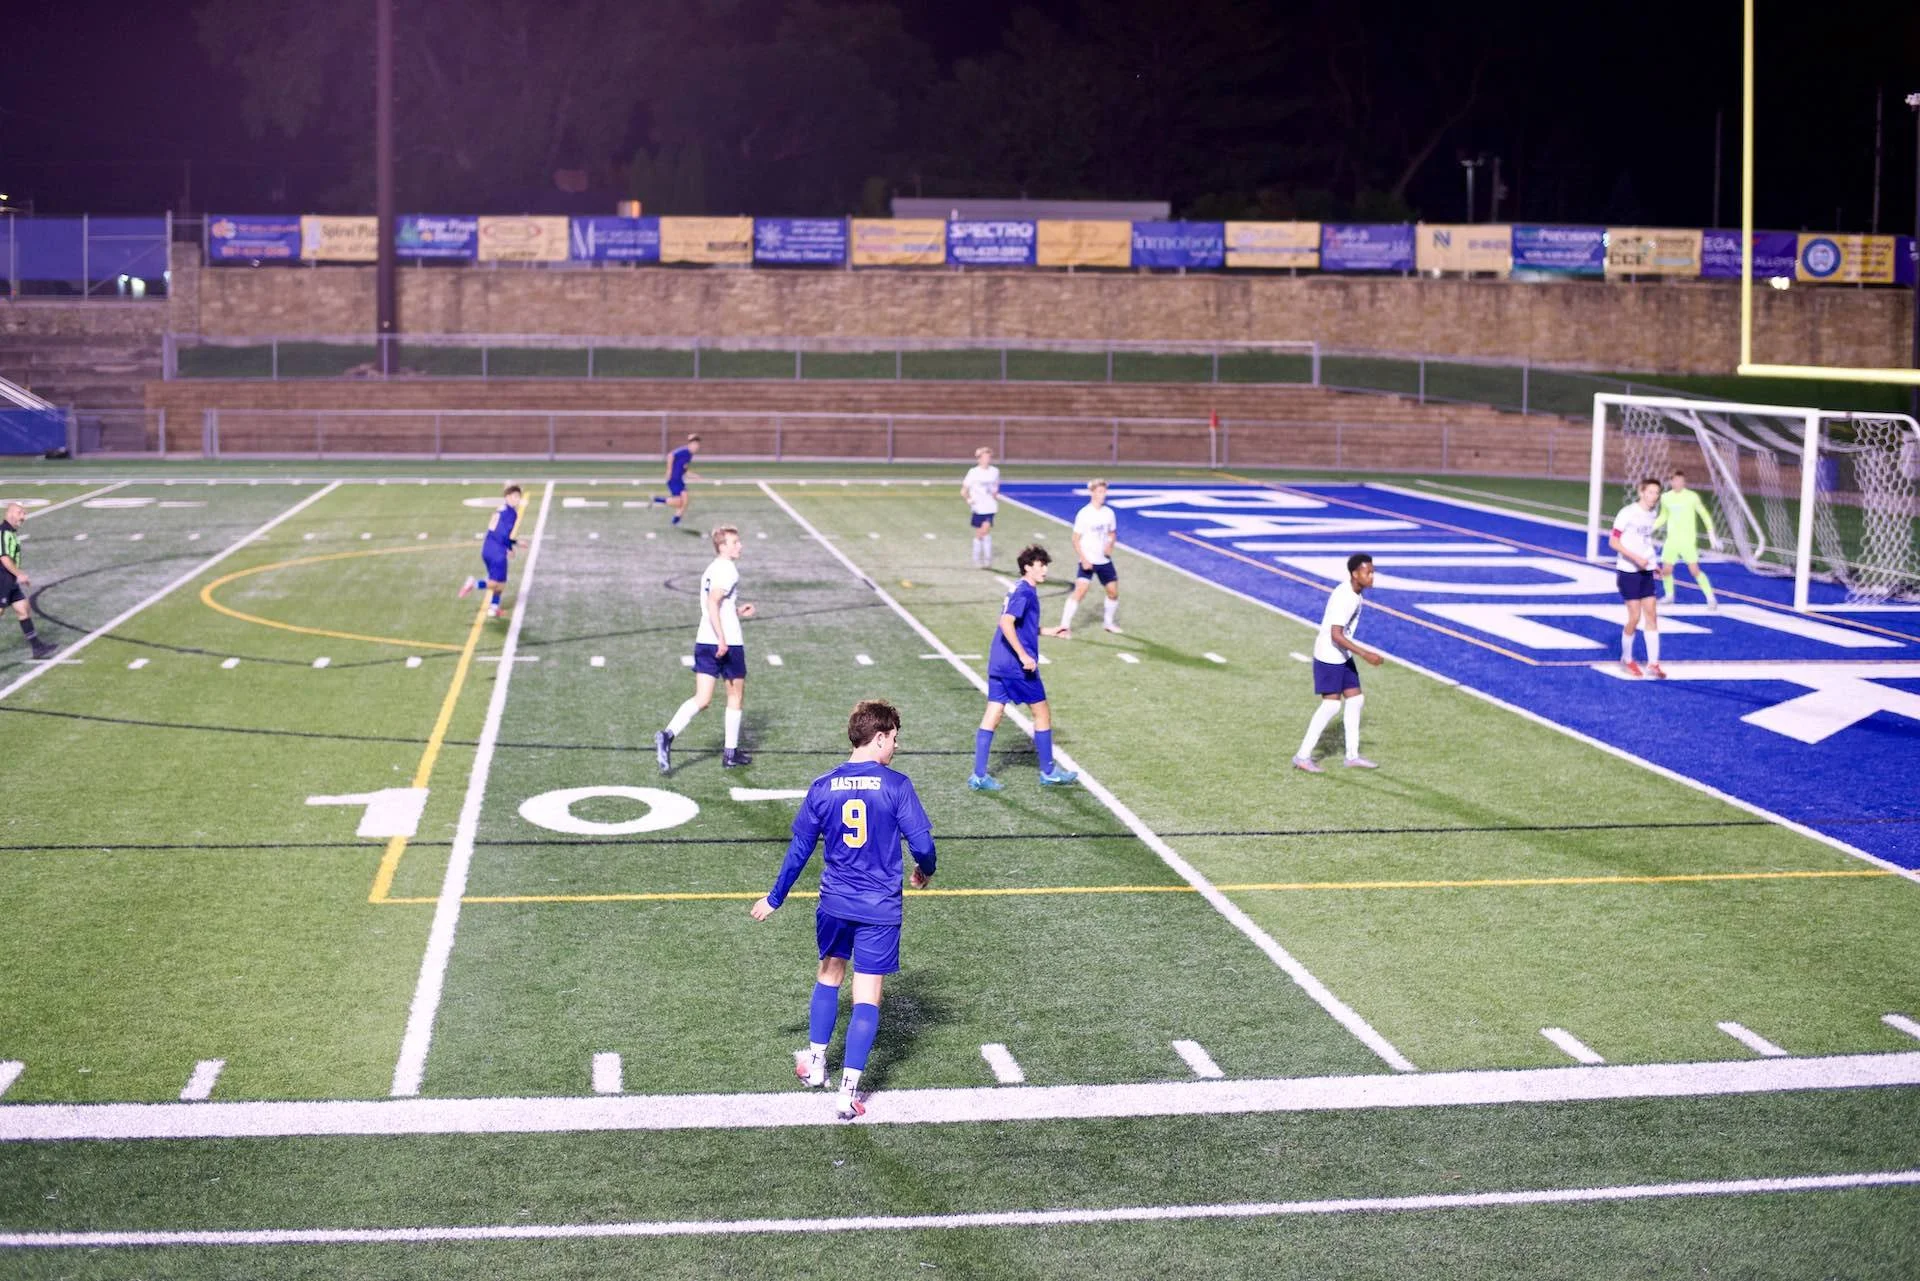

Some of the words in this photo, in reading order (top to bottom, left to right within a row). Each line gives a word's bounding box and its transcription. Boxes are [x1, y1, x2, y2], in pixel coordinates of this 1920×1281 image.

[949, 222, 1034, 238] SPECTRO
[830, 776, 881, 792] HASTINGS
[304, 786, 700, 837] 10
[842, 799, 867, 848] 9
